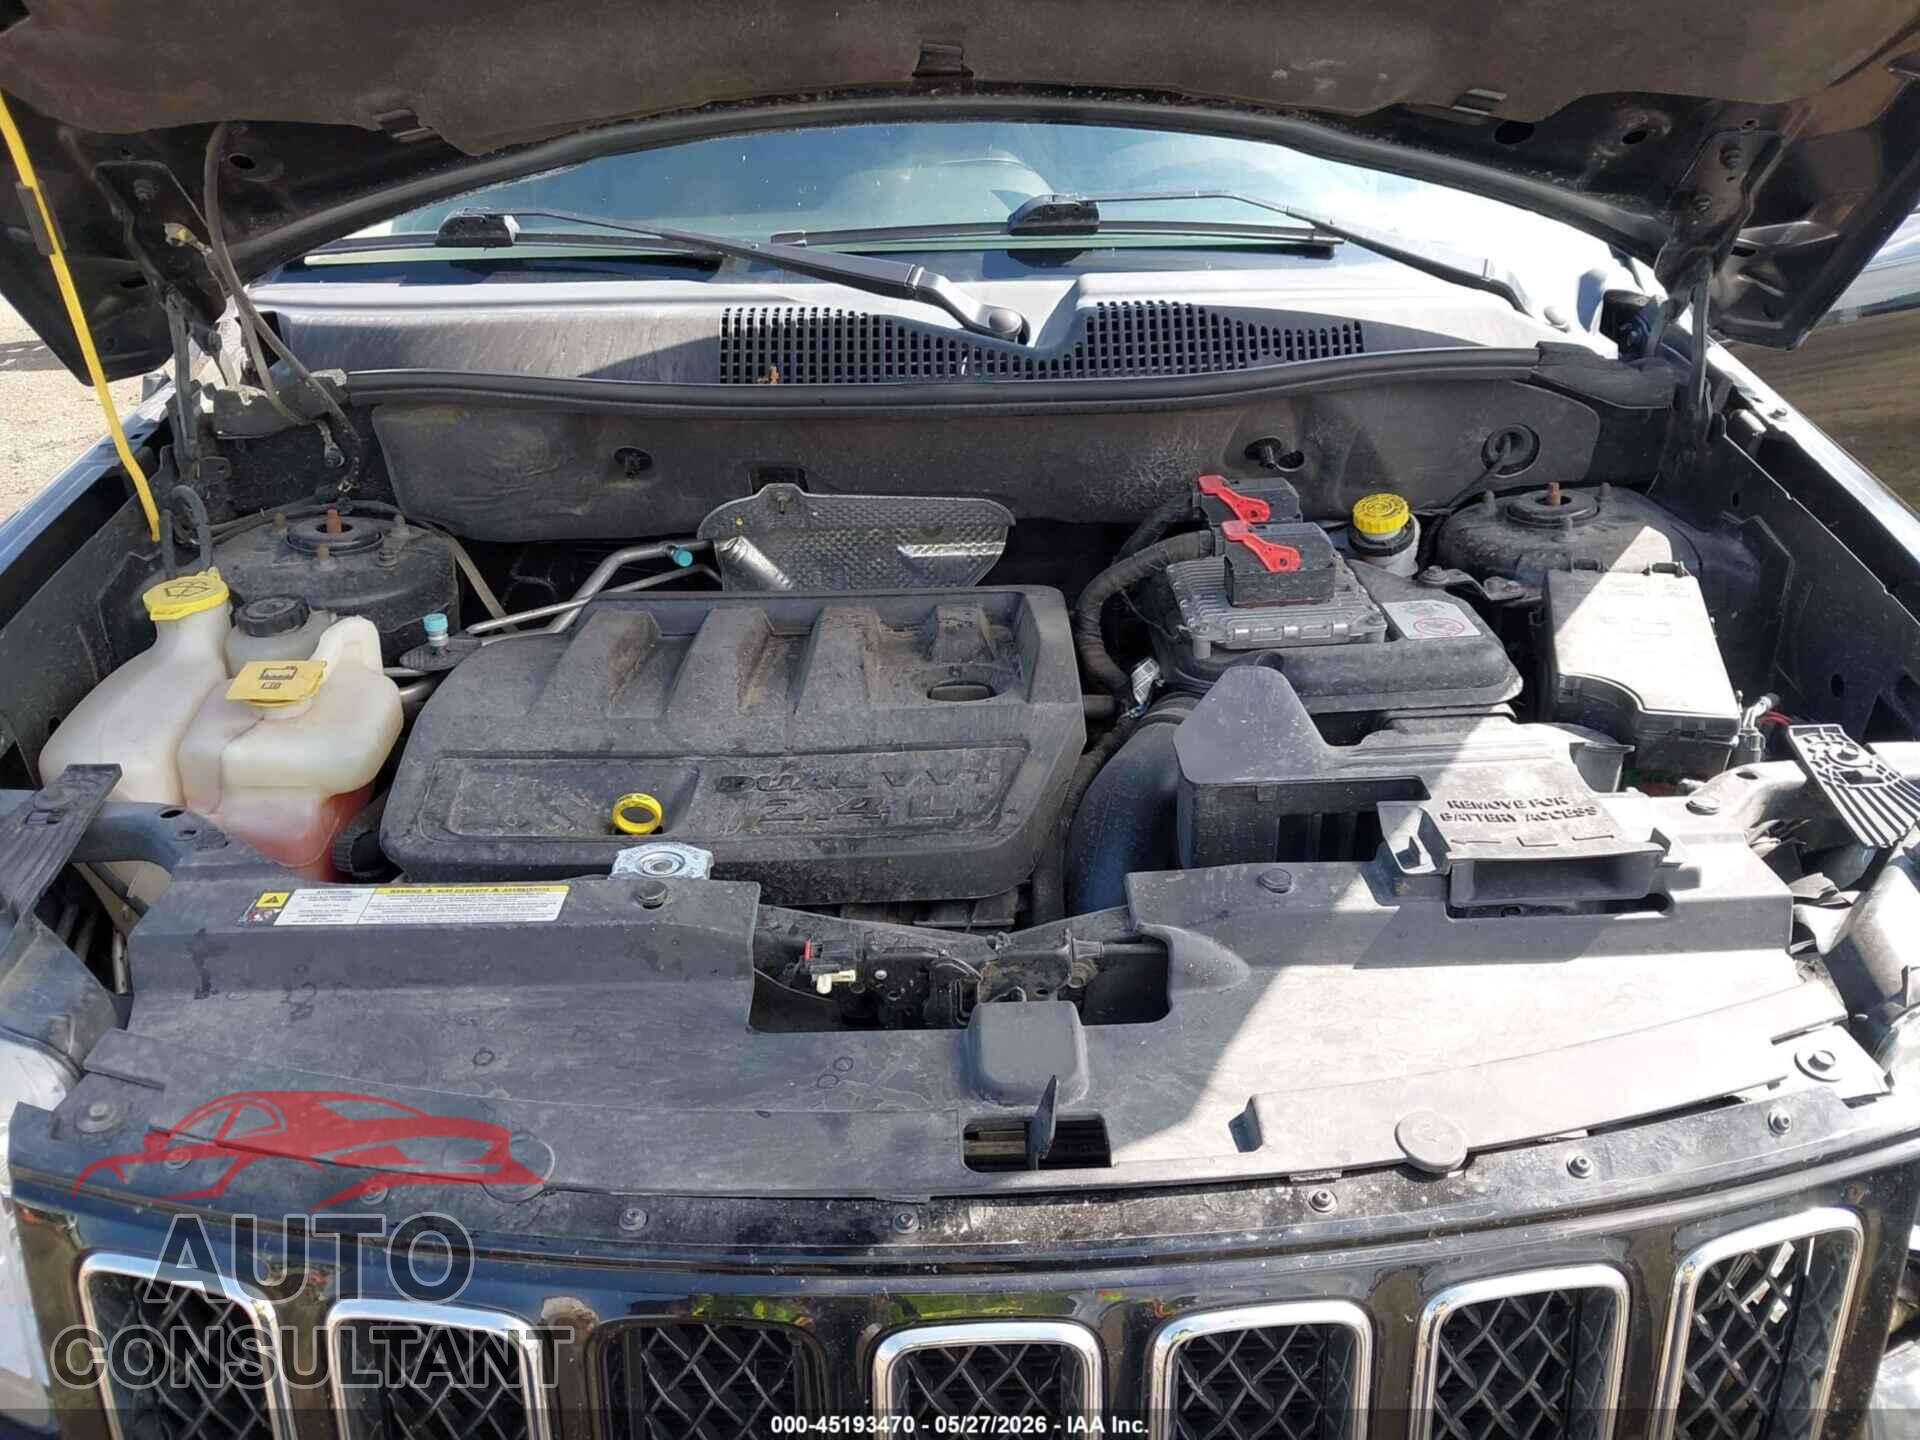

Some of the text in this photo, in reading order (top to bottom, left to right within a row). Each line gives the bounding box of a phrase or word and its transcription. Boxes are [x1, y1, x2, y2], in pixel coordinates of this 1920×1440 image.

[1447, 796, 1569, 810] REMOVE FOR
[1439, 806, 1598, 823] BATTERY ACCESS
